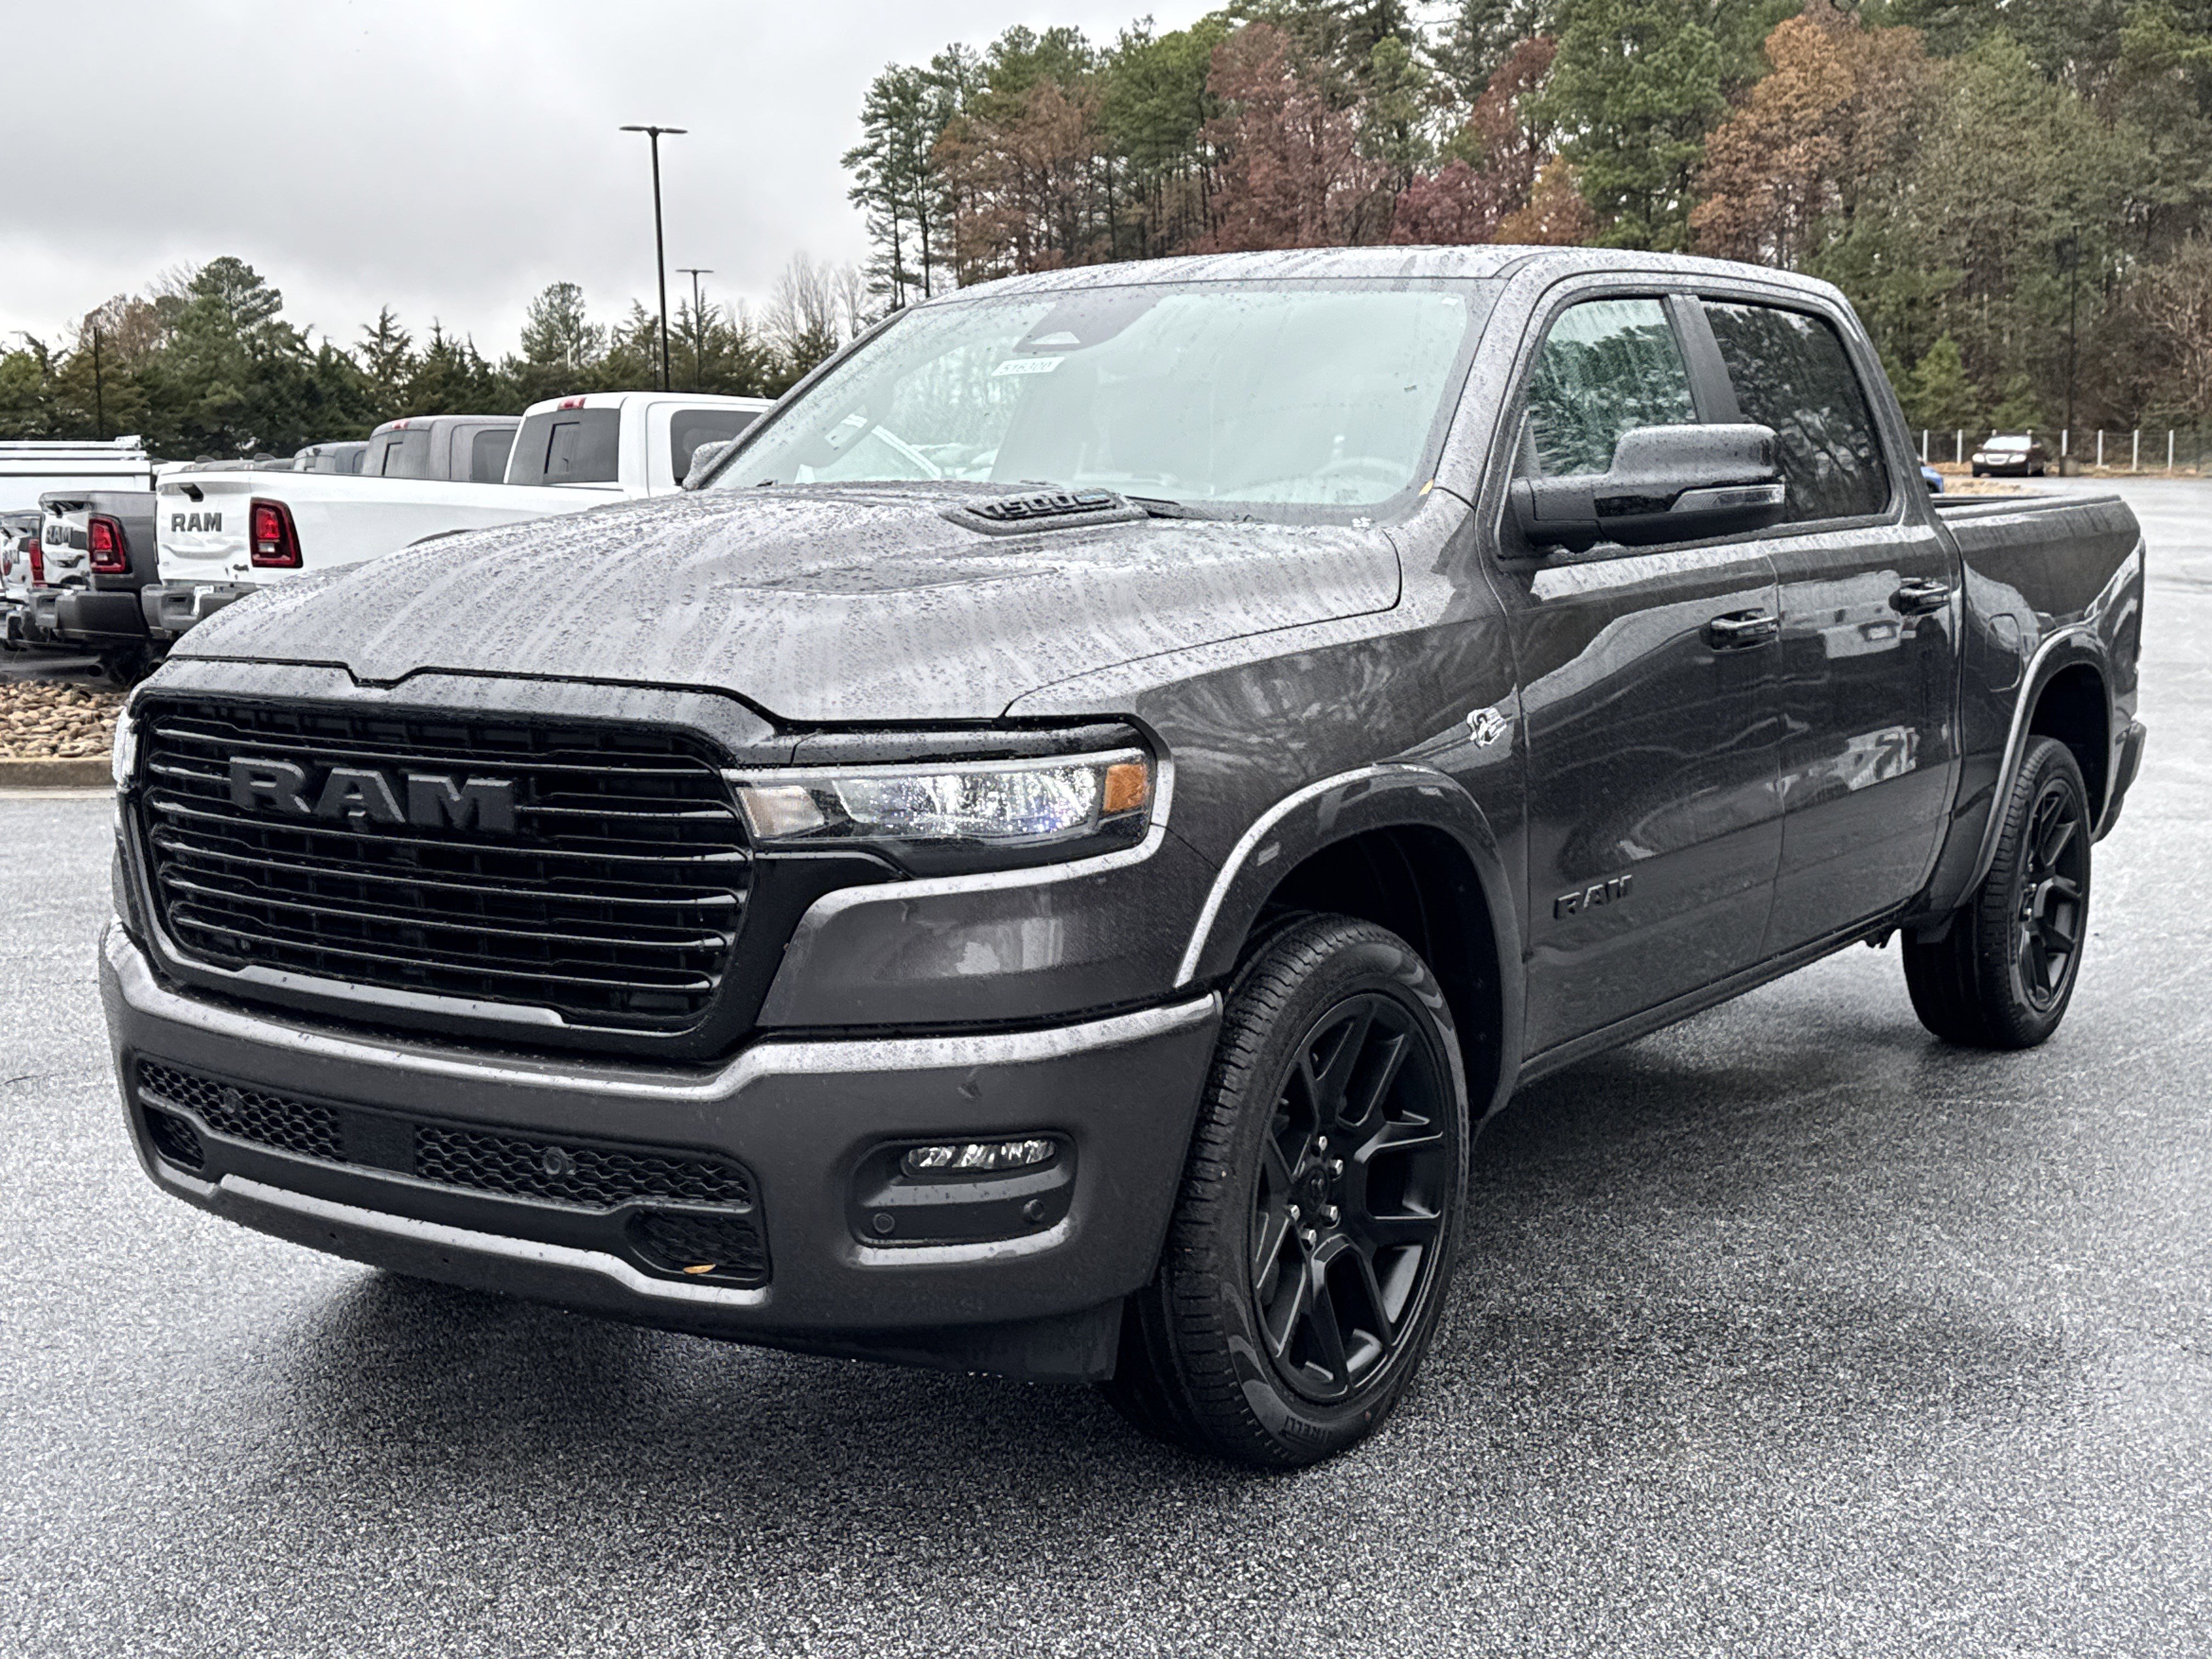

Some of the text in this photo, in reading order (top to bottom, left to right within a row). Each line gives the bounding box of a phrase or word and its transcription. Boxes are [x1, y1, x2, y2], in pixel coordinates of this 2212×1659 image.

[46, 525, 74, 545] RAM
[171, 512, 222, 532] RAM
[229, 756, 517, 833] RAM
[1553, 874, 1633, 919] RAM
